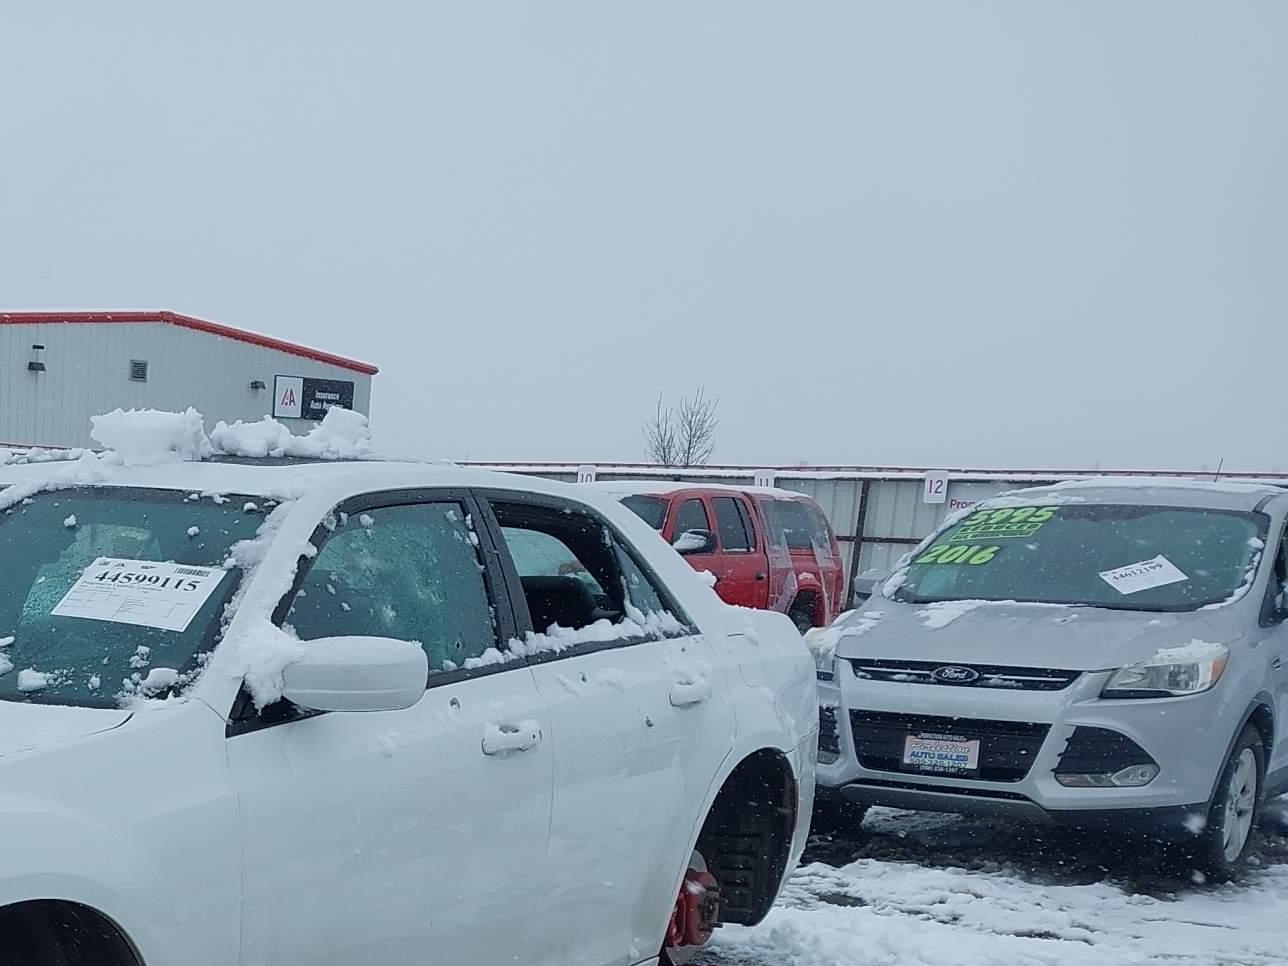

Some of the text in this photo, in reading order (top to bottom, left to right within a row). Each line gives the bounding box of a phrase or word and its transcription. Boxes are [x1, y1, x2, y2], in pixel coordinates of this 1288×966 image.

[929, 480, 944, 494] 12
[963, 506, 1060, 526] 5995
[916, 545, 1001, 565] 2016
[94, 571, 201, 592] 44599115
[942, 668, 968, 679] Ford
[910, 751, 935, 760] AUTO
